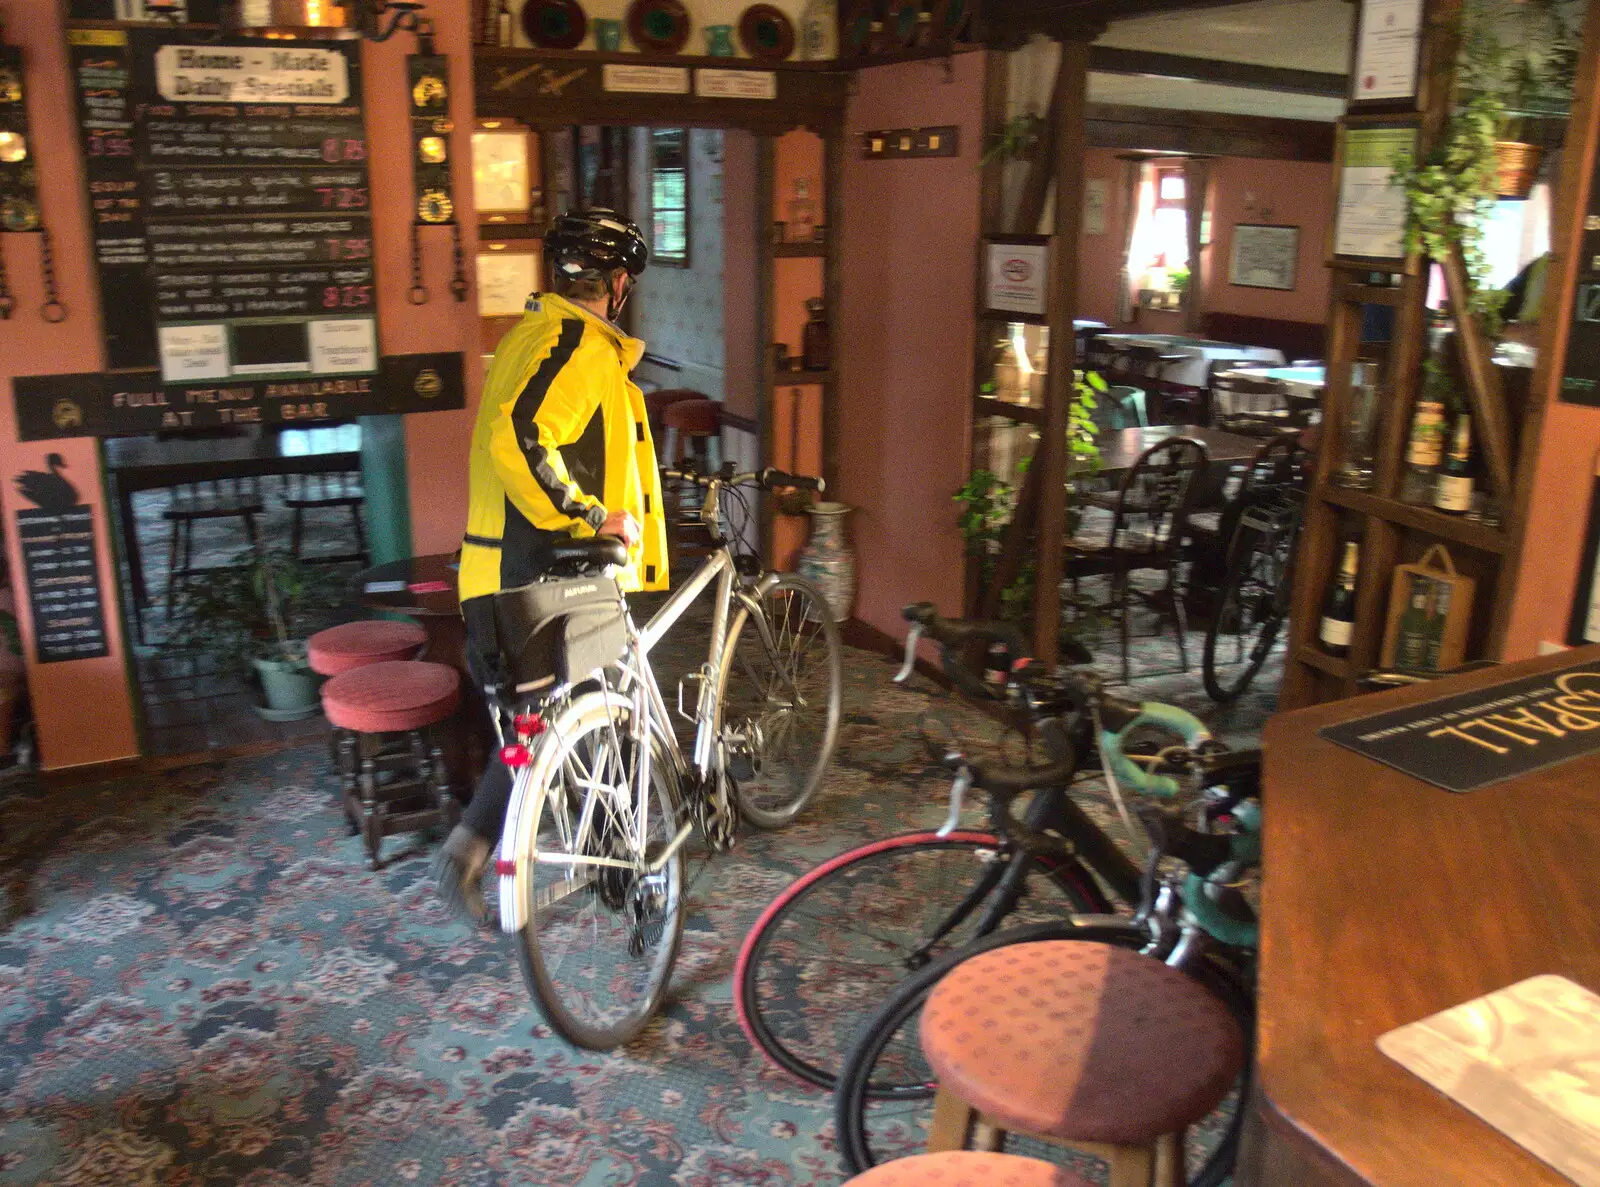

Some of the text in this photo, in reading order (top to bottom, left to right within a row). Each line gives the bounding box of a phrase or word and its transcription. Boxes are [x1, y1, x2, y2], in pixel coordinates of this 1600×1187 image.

[176, 49, 244, 69] Home
[113, 378, 372, 407] FULL MENU AVAILABLE
[163, 402, 330, 427] AT THE BAR
